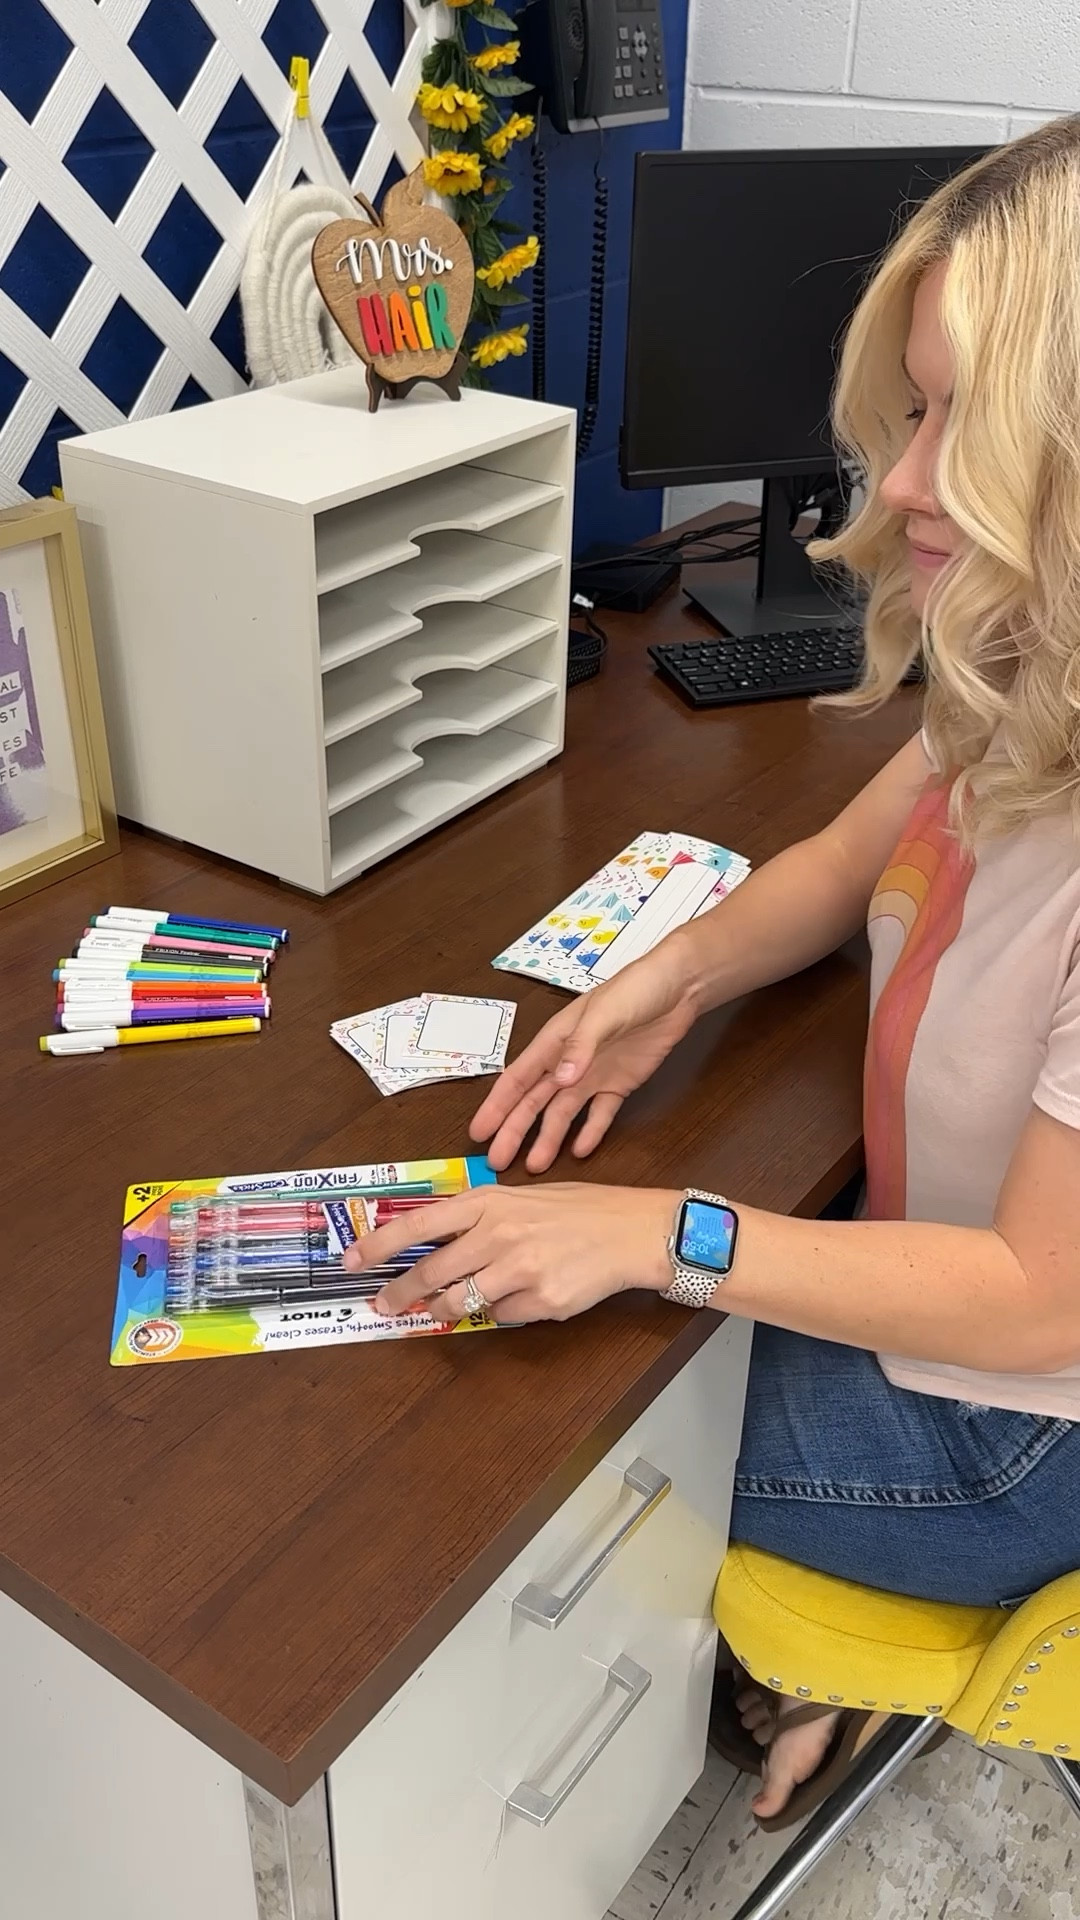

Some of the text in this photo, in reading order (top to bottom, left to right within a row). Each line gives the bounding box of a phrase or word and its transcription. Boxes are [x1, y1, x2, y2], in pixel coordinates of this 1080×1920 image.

[336, 237, 453, 284] Mrs.
[682, 1240, 709, 1255] 10:50
[280, 1310, 331, 1322] PILOT
[265, 1330, 301, 1341] Clean!
[305, 1325, 343, 1336] Erases
